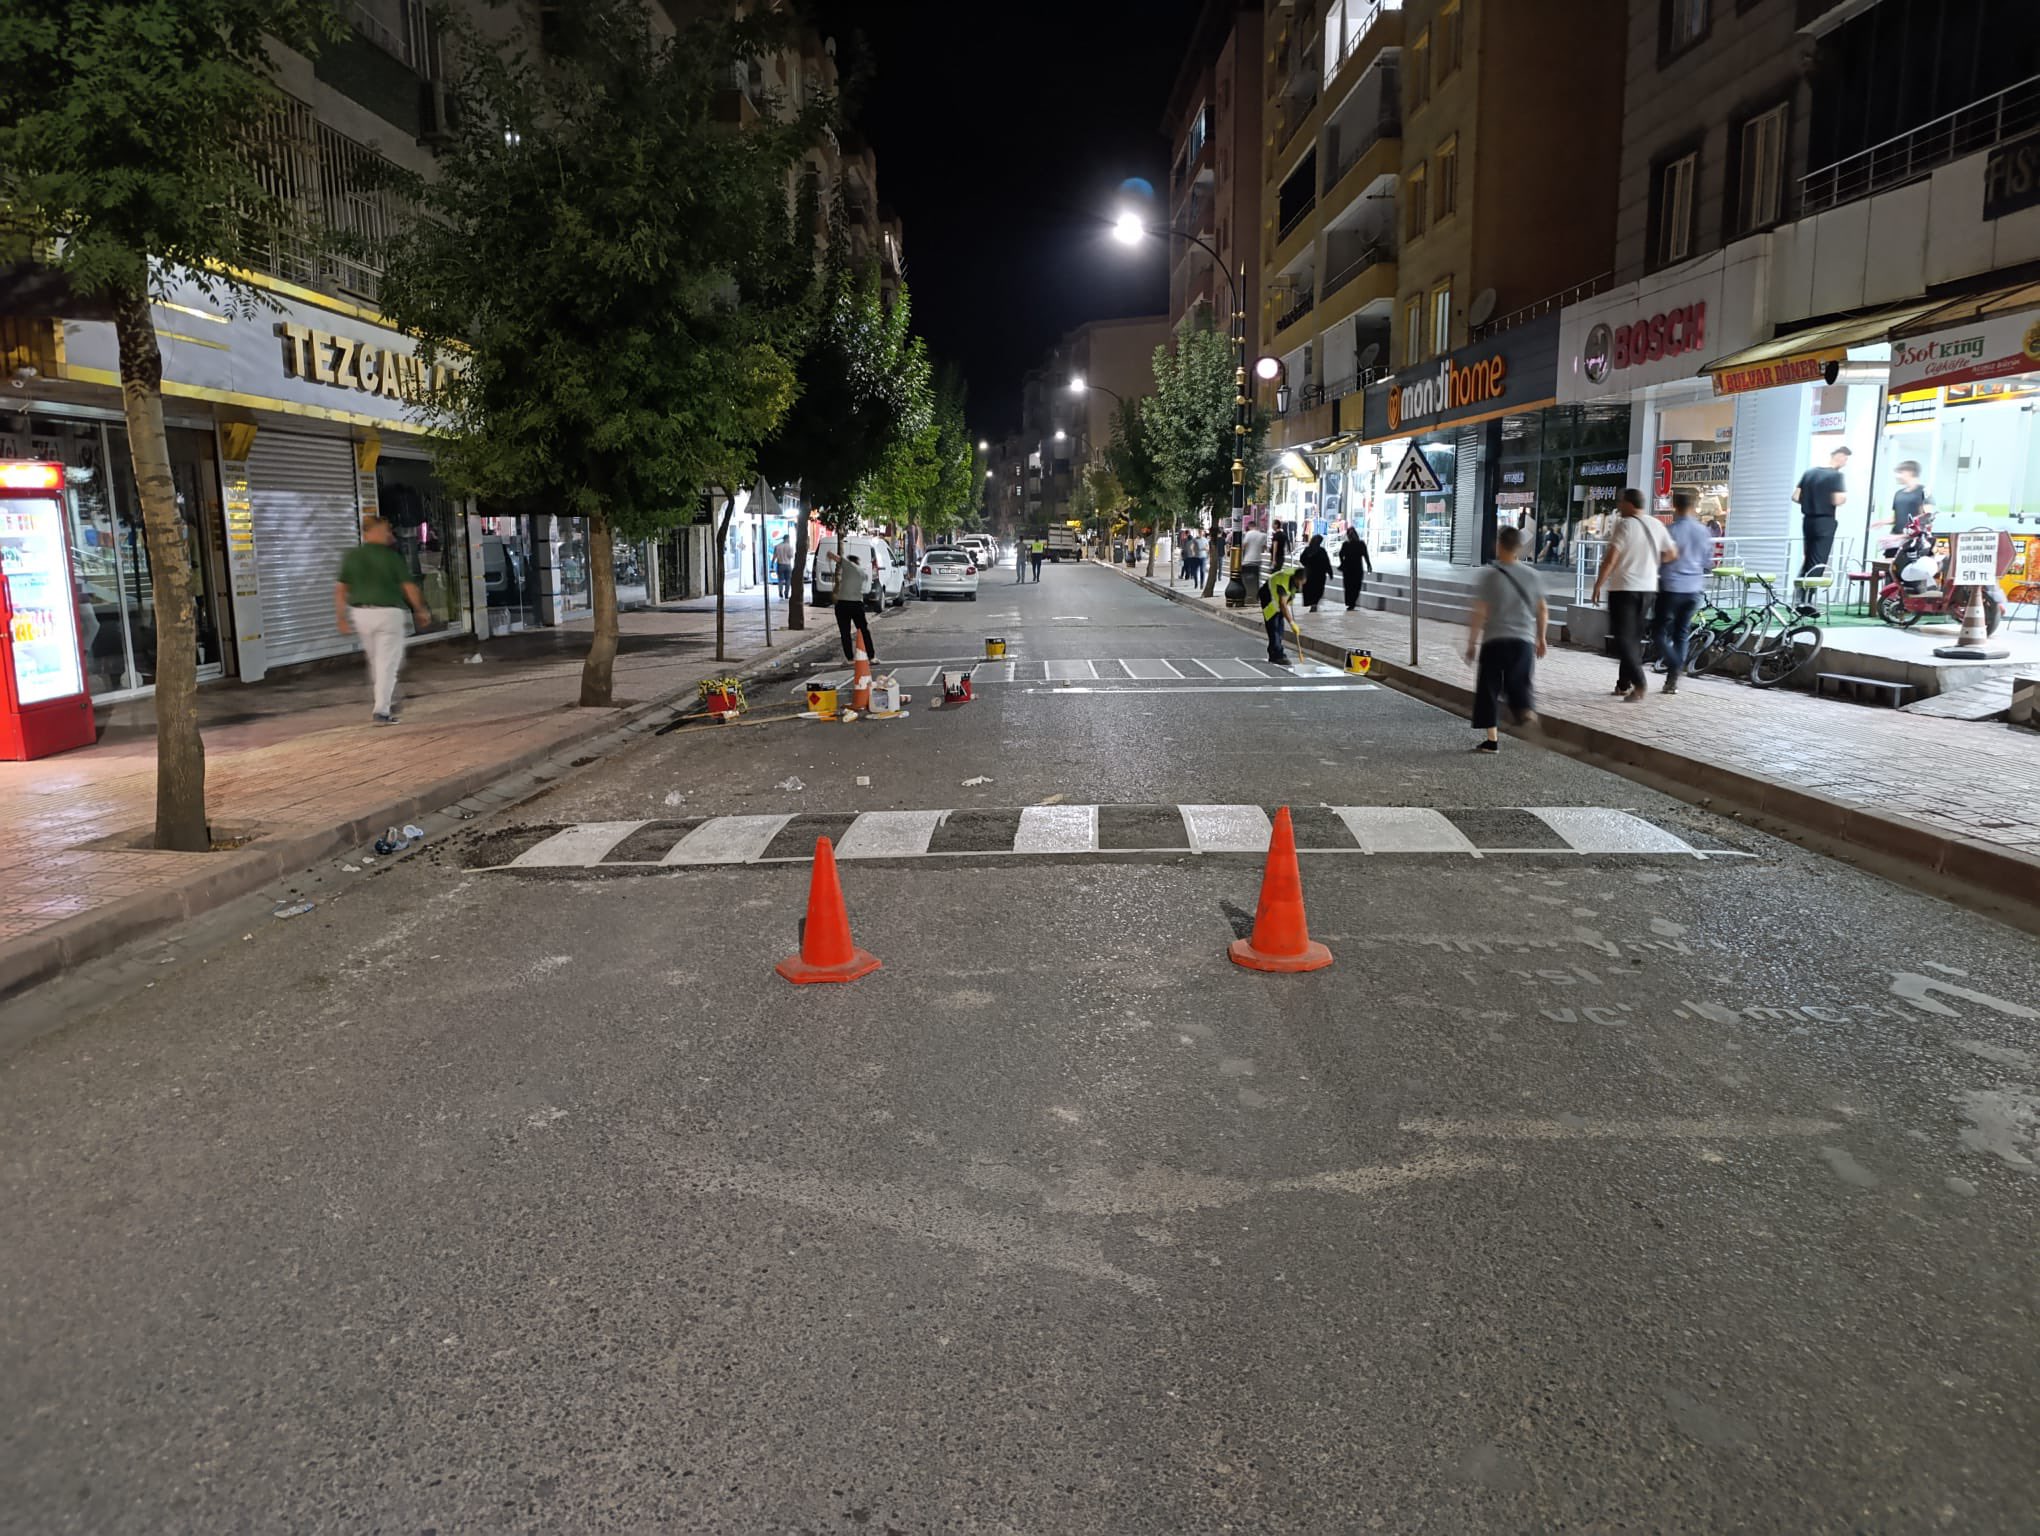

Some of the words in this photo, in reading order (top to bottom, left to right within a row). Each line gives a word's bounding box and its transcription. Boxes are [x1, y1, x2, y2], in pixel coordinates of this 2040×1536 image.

[1613, 301, 1706, 369] BOSCH
[1727, 367, 1773, 391] BULVAR
[1776, 359, 1820, 382] DÖNER
[1820, 416, 1843, 427] BOSCH
[1961, 553, 1992, 564] DÜRÜM
[1962, 570, 1976, 581] 50
